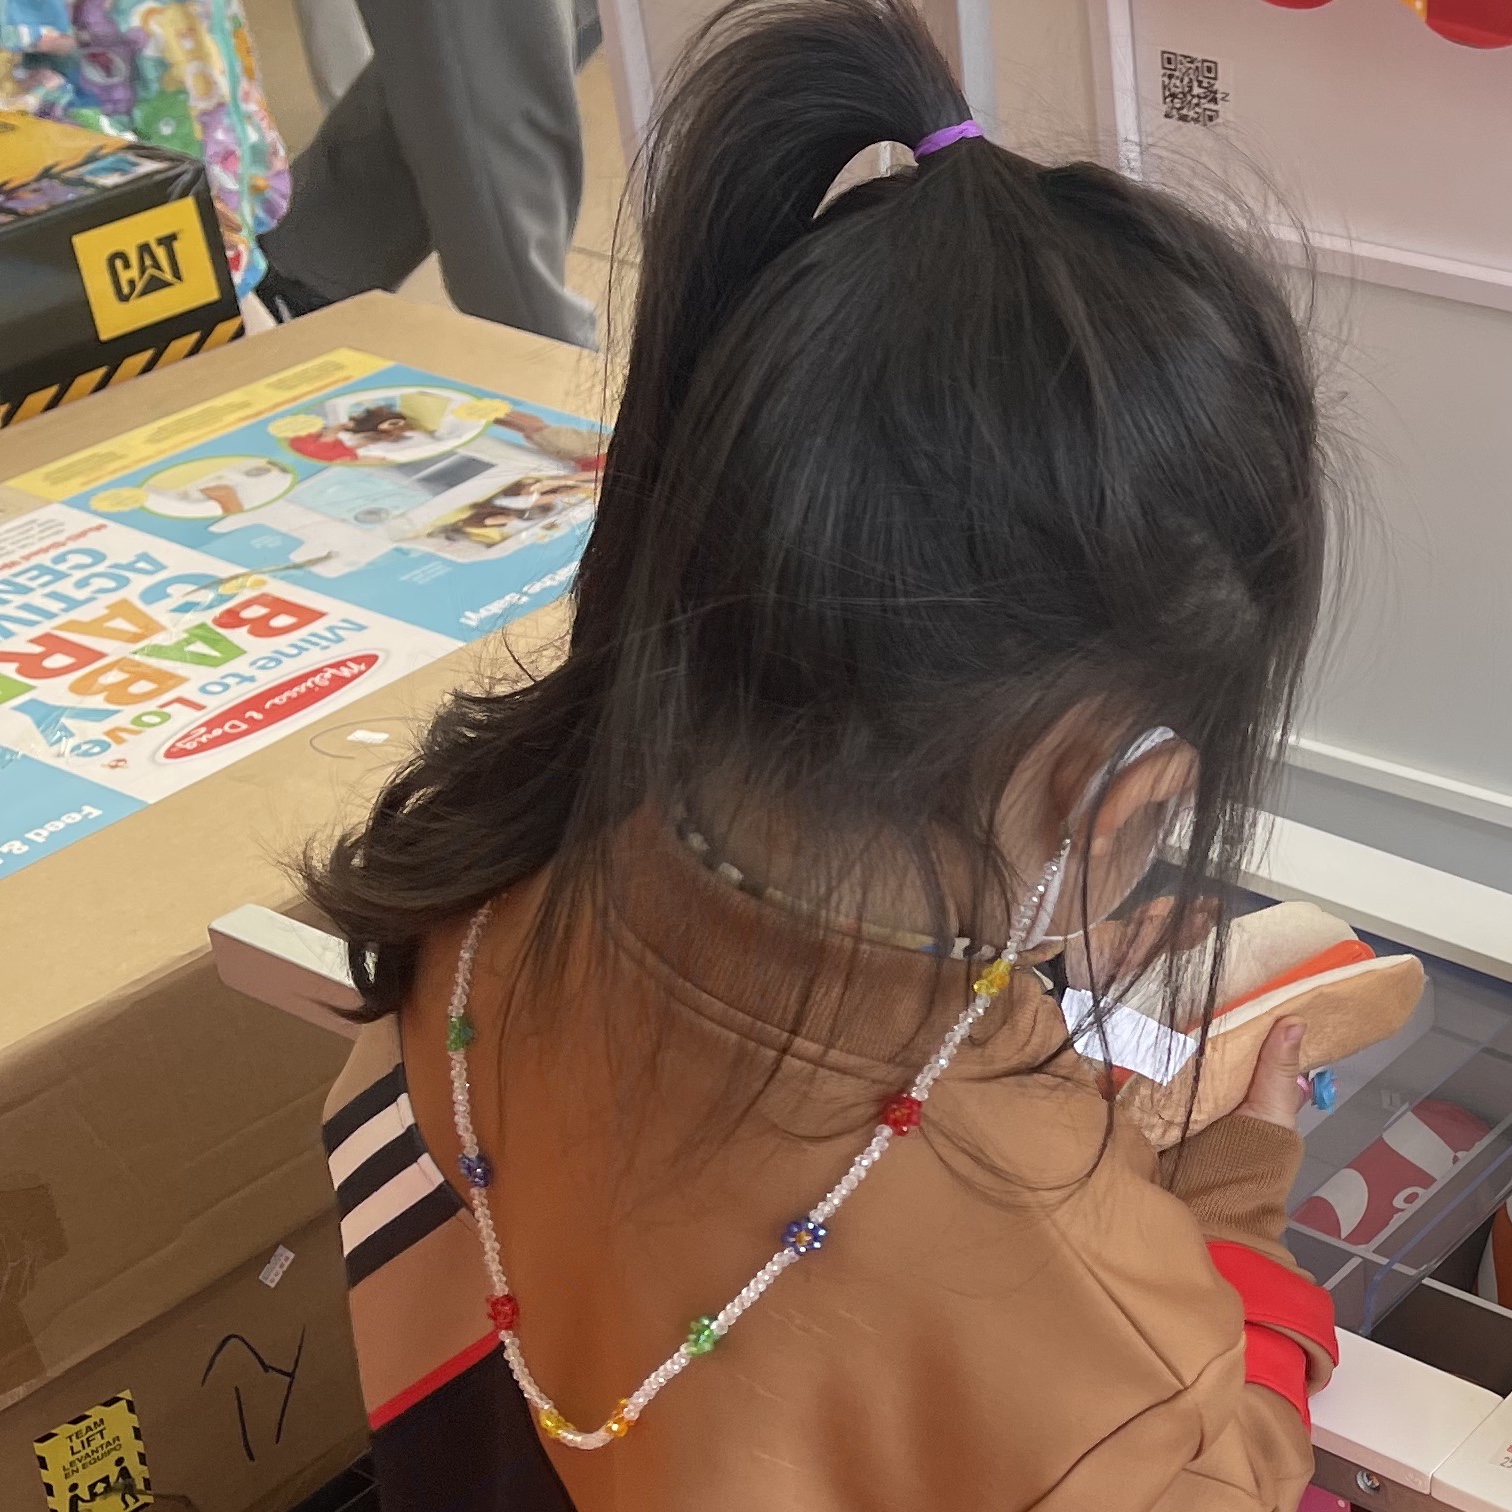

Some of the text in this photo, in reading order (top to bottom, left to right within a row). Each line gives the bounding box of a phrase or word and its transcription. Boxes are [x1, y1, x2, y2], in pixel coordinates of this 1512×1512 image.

[106, 232, 182, 302] CAT
[9, 591, 329, 748] BABY
[70, 617, 369, 758] Mine to Love
[264, 660, 367, 710] Melissa
[176, 719, 249, 751] Doug
[24, 804, 104, 843] Feed
[66, 1417, 105, 1443] TEAM
[69, 1427, 107, 1457] LIFT
[62, 1435, 121, 1473] LEVANTAR
[64, 1443, 122, 1480] EN EQUIPO
